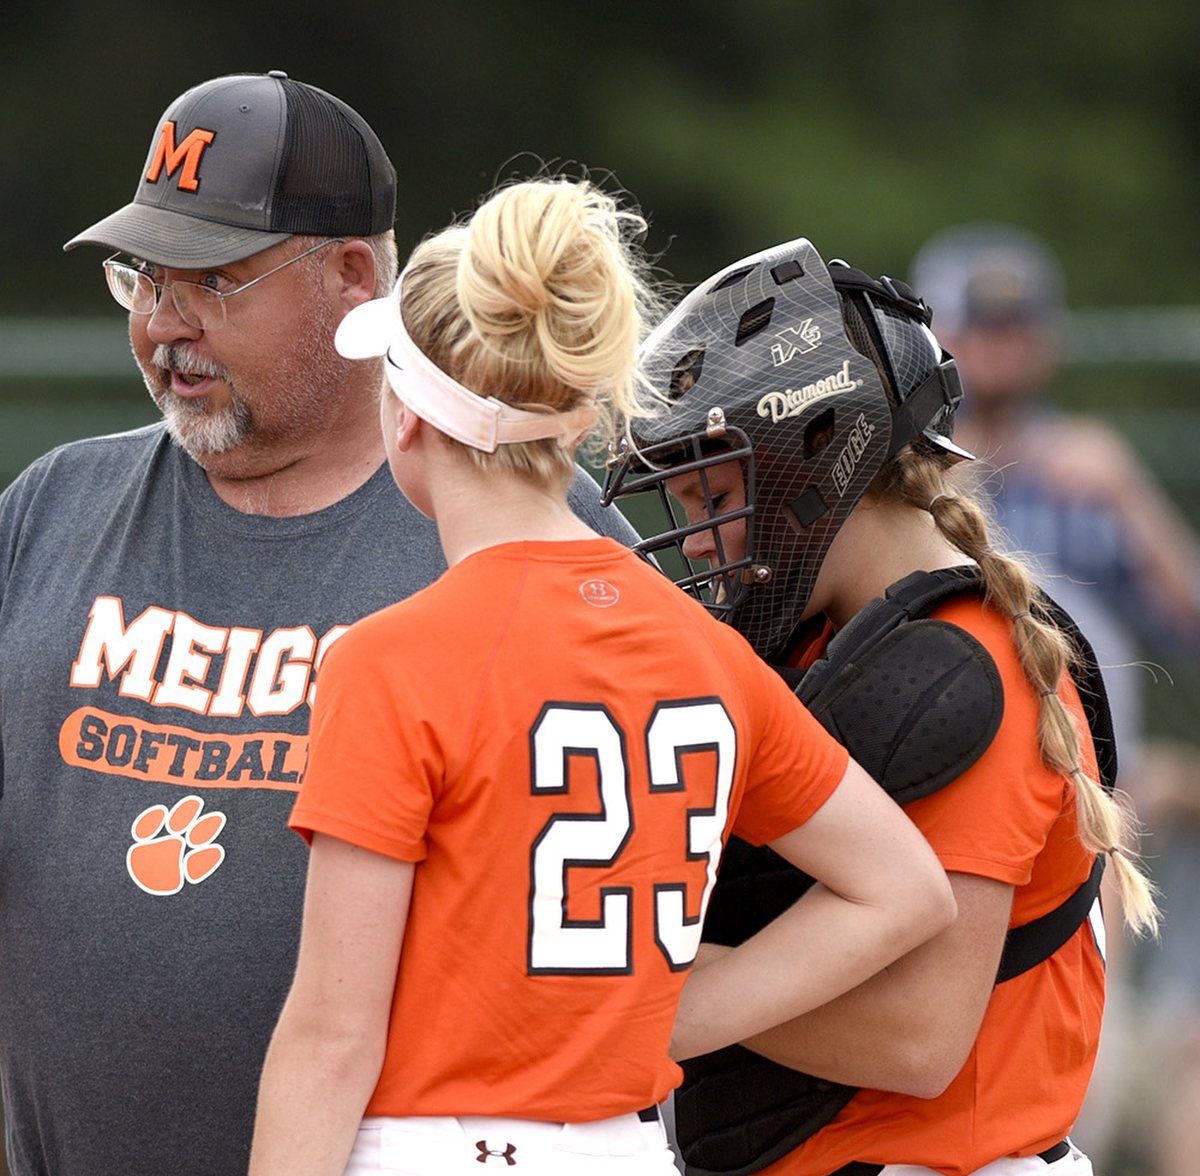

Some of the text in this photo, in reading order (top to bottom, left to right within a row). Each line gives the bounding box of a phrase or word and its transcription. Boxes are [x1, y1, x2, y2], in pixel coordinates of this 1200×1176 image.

[146, 120, 215, 193] M
[757, 360, 858, 423] Diamond
[831, 413, 873, 497] EDGE
[76, 714, 310, 784] SOFTBAL
[527, 696, 737, 976] 23
